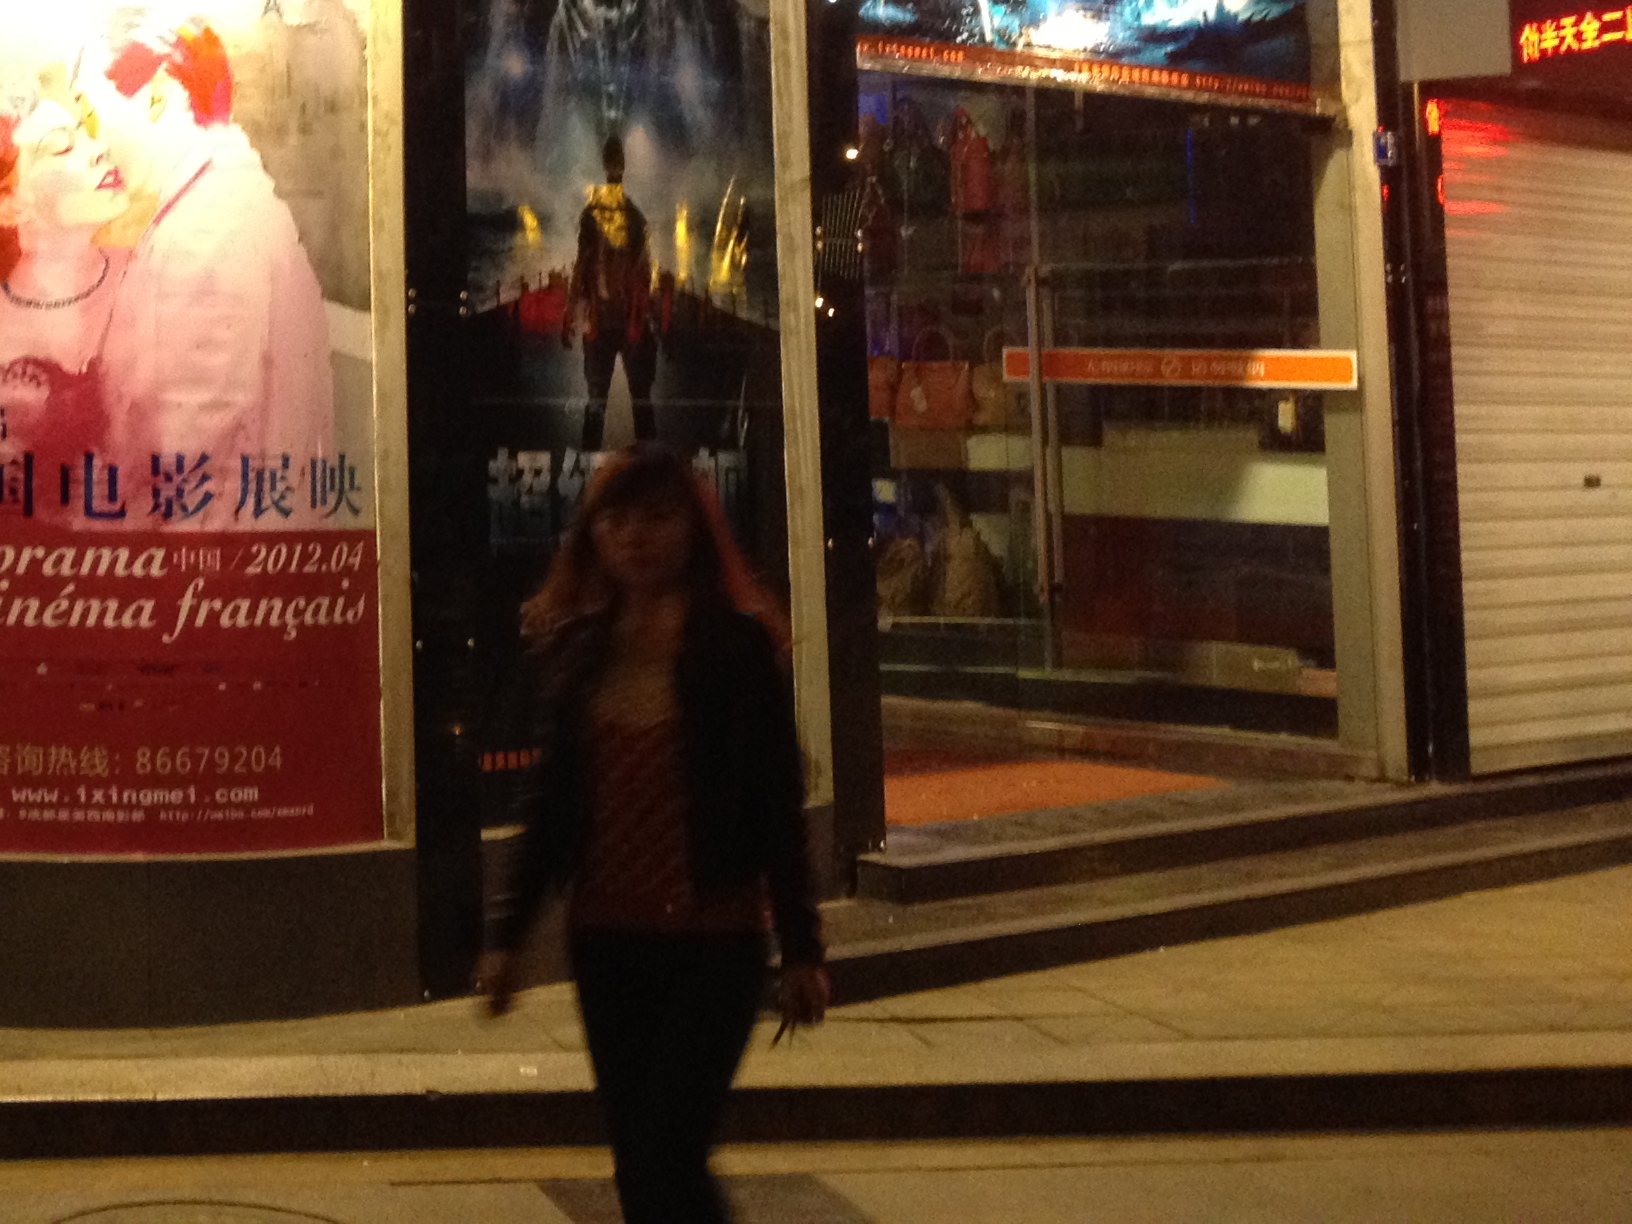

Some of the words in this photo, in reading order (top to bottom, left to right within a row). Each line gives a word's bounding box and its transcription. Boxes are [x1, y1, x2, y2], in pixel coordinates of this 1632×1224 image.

[173, 546, 222, 572] 中国
[244, 540, 365, 575] 2012.04
[161, 577, 366, 644] français
[135, 743, 283, 774] 86679204
